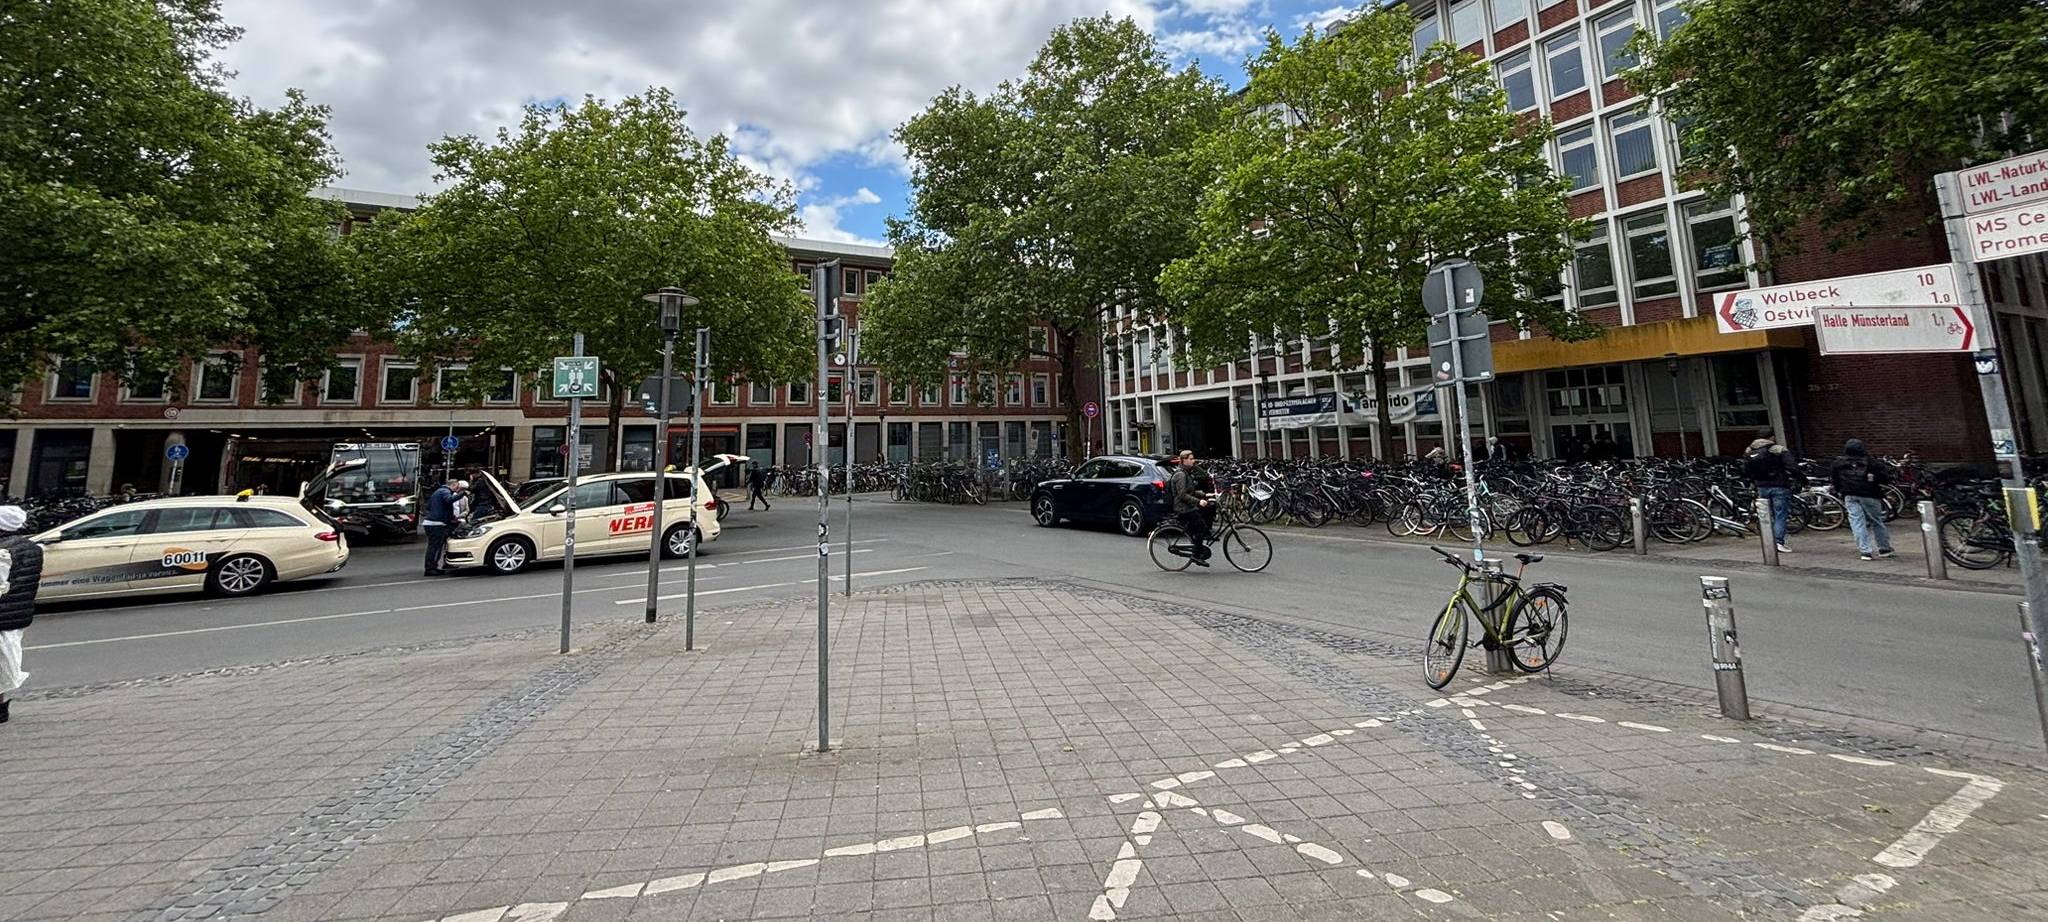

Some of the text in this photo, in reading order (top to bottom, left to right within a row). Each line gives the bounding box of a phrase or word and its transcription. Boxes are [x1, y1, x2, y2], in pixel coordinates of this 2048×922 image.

[1967, 159, 2048, 188] LWL-Naturk
[1971, 178, 2048, 206] LWL-Land
[1976, 212, 2046, 234] MS Ce
[1980, 232, 2048, 253] Prome
[1761, 273, 1935, 305] Wolbeck 10
[1764, 306, 1817, 322] Ostvi
[1822, 313, 1849, 328] Halle
[1850, 312, 1910, 328] Münsterland
[163, 551, 205, 566] 60011
